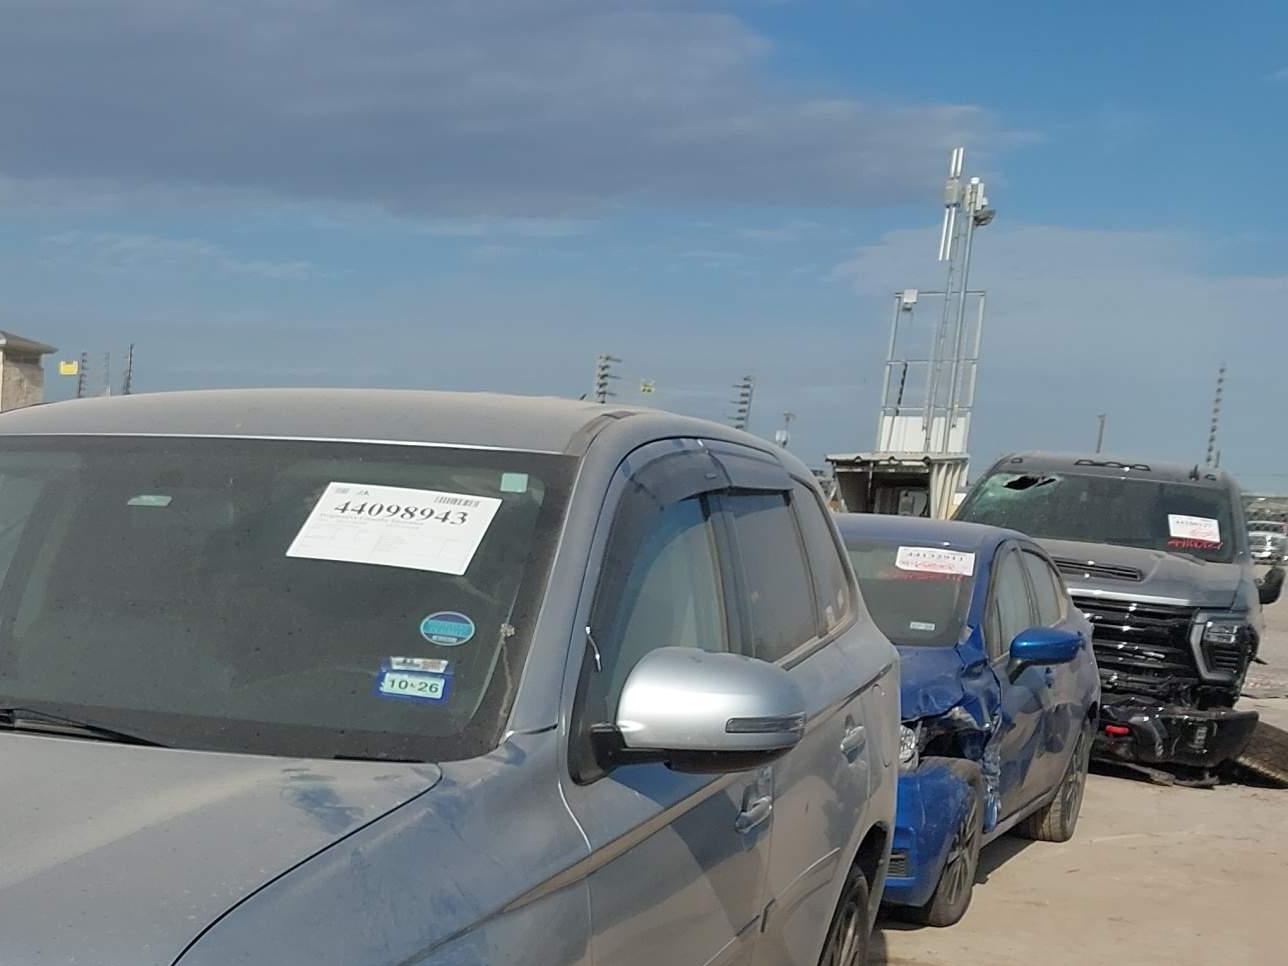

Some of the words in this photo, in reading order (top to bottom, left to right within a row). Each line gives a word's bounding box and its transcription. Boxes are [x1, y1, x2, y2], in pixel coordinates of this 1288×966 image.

[333, 500, 470, 525] 44098943
[389, 679, 409, 691] 10
[417, 681, 440, 694] 26
